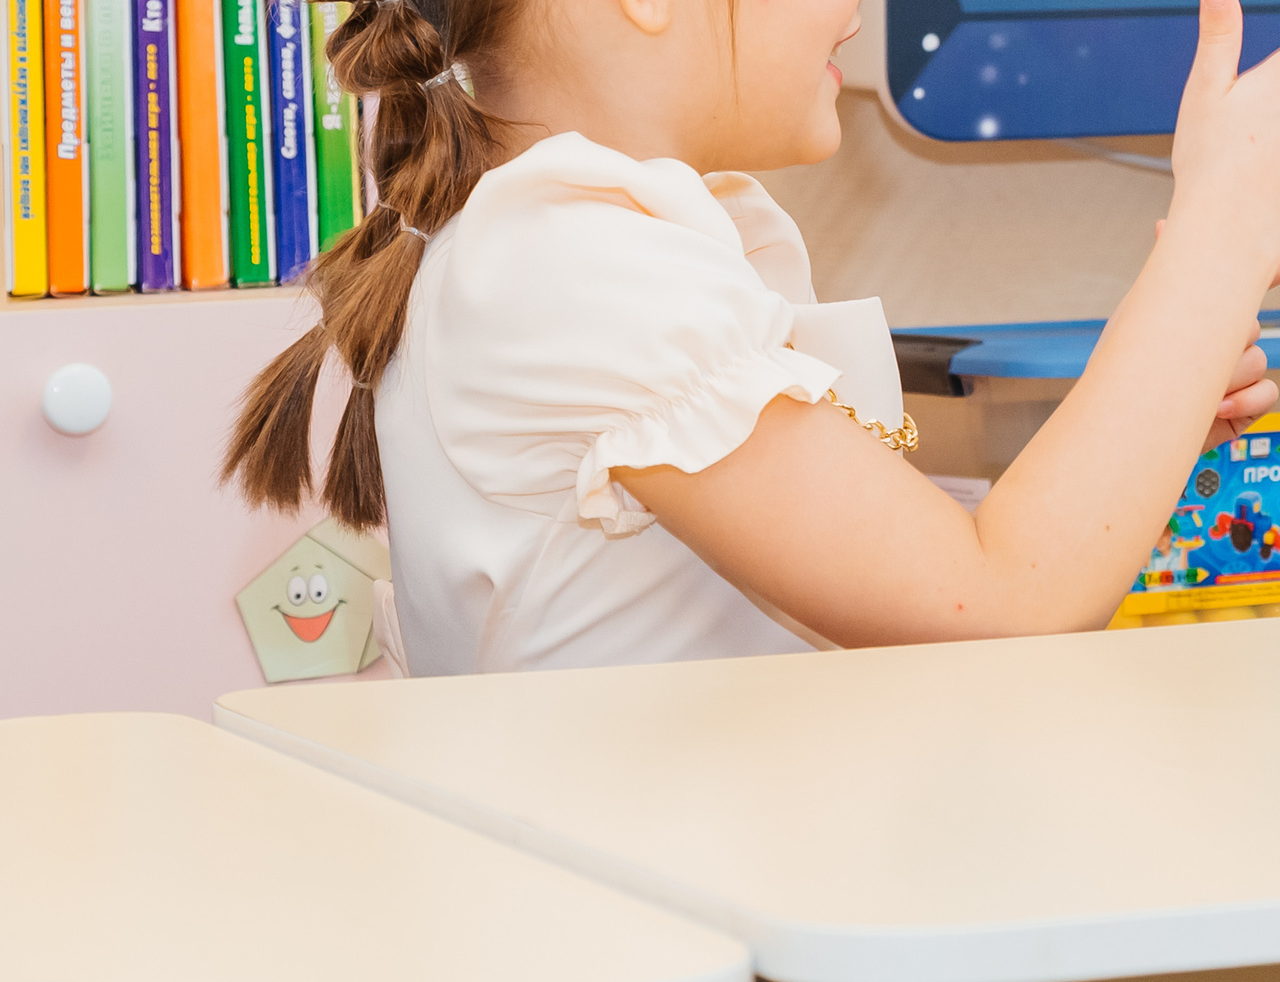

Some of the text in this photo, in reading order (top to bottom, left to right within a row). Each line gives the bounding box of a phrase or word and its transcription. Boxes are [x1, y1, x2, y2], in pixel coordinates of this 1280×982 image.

[142, 0, 163, 32] Кто
[59, 34, 75, 48] и
[146, 44, 158, 80] лото
[57, 51, 80, 159] Предметы
[147, 92, 161, 128] игра
[280, 102, 299, 160] Слоги,
